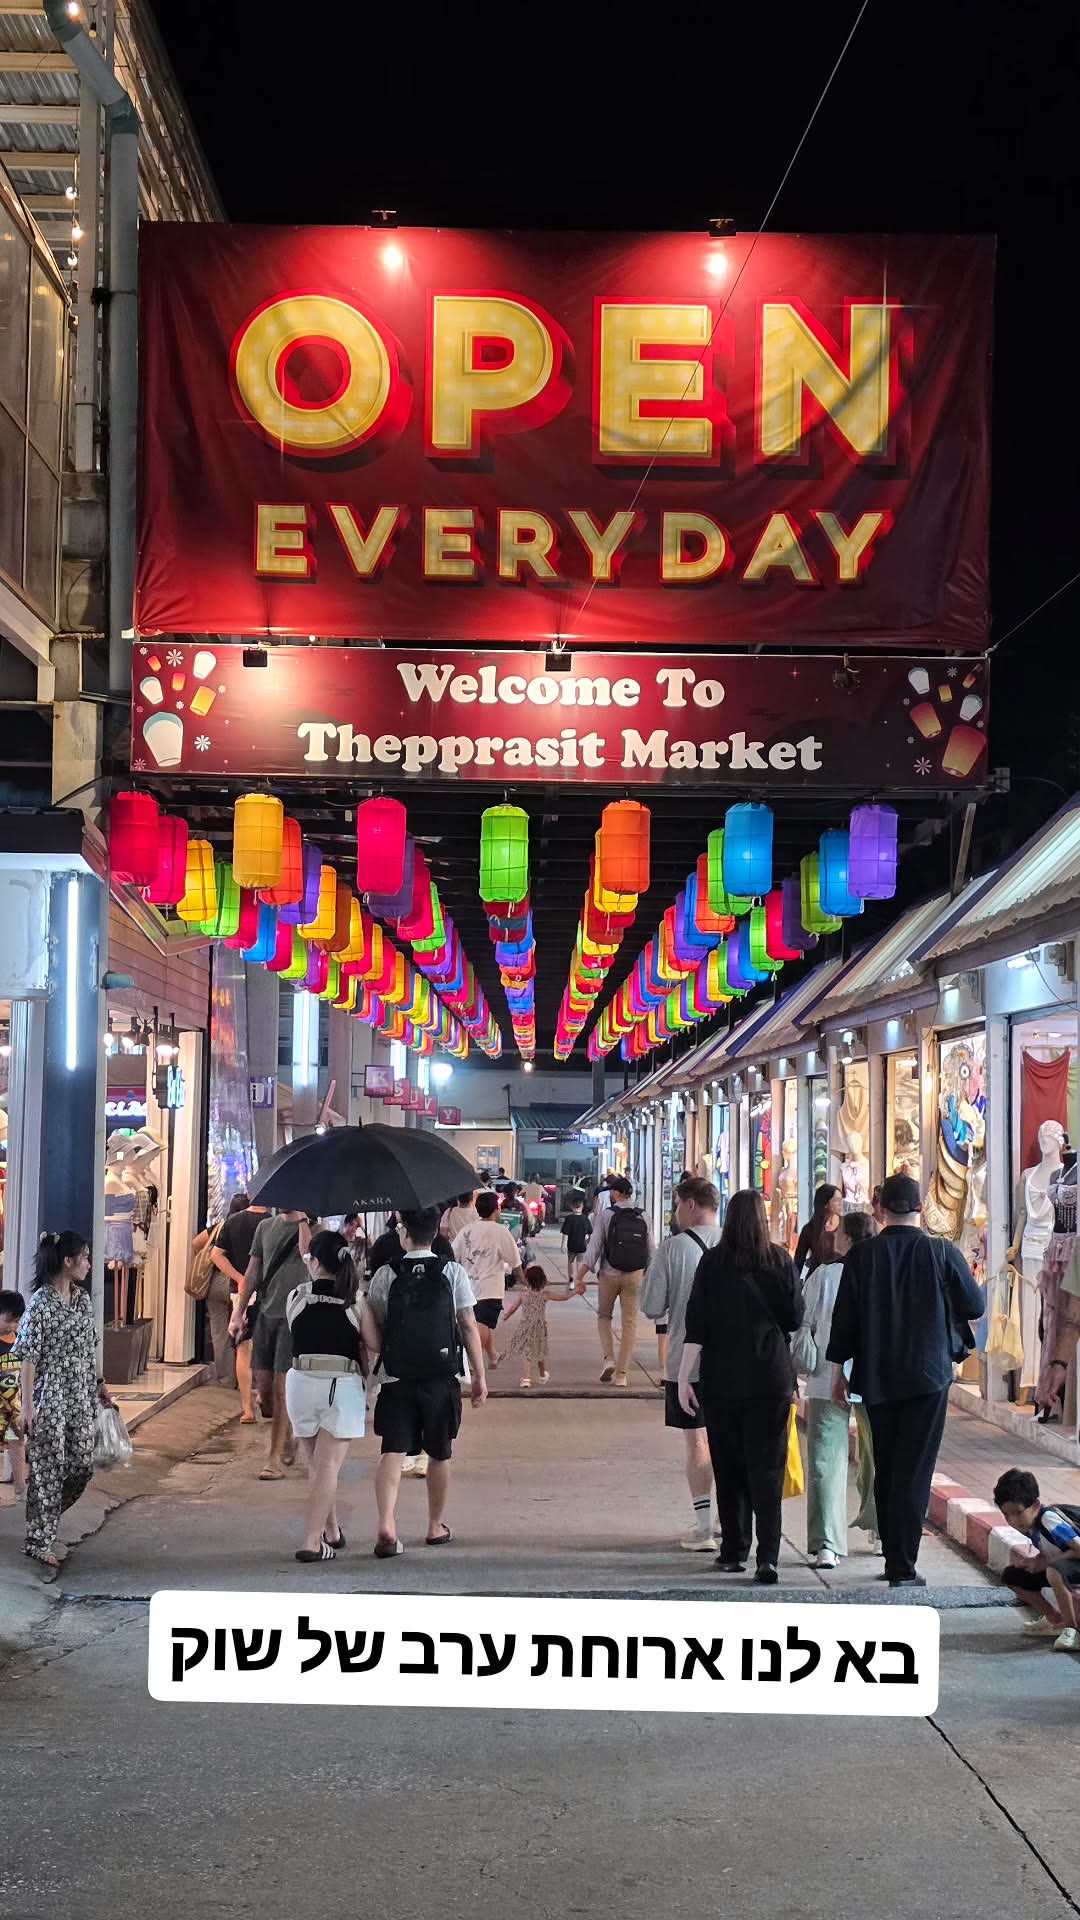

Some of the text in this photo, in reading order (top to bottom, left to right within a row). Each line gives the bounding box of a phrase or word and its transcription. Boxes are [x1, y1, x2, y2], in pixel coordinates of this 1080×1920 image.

[233, 293, 897, 458] OPEN
[257, 505, 884, 582] EVERYDAY
[396, 662, 725, 708] Welcome To
[297, 721, 824, 773] Thepprasit Market
[353, 1196, 392, 1207] AKARA
